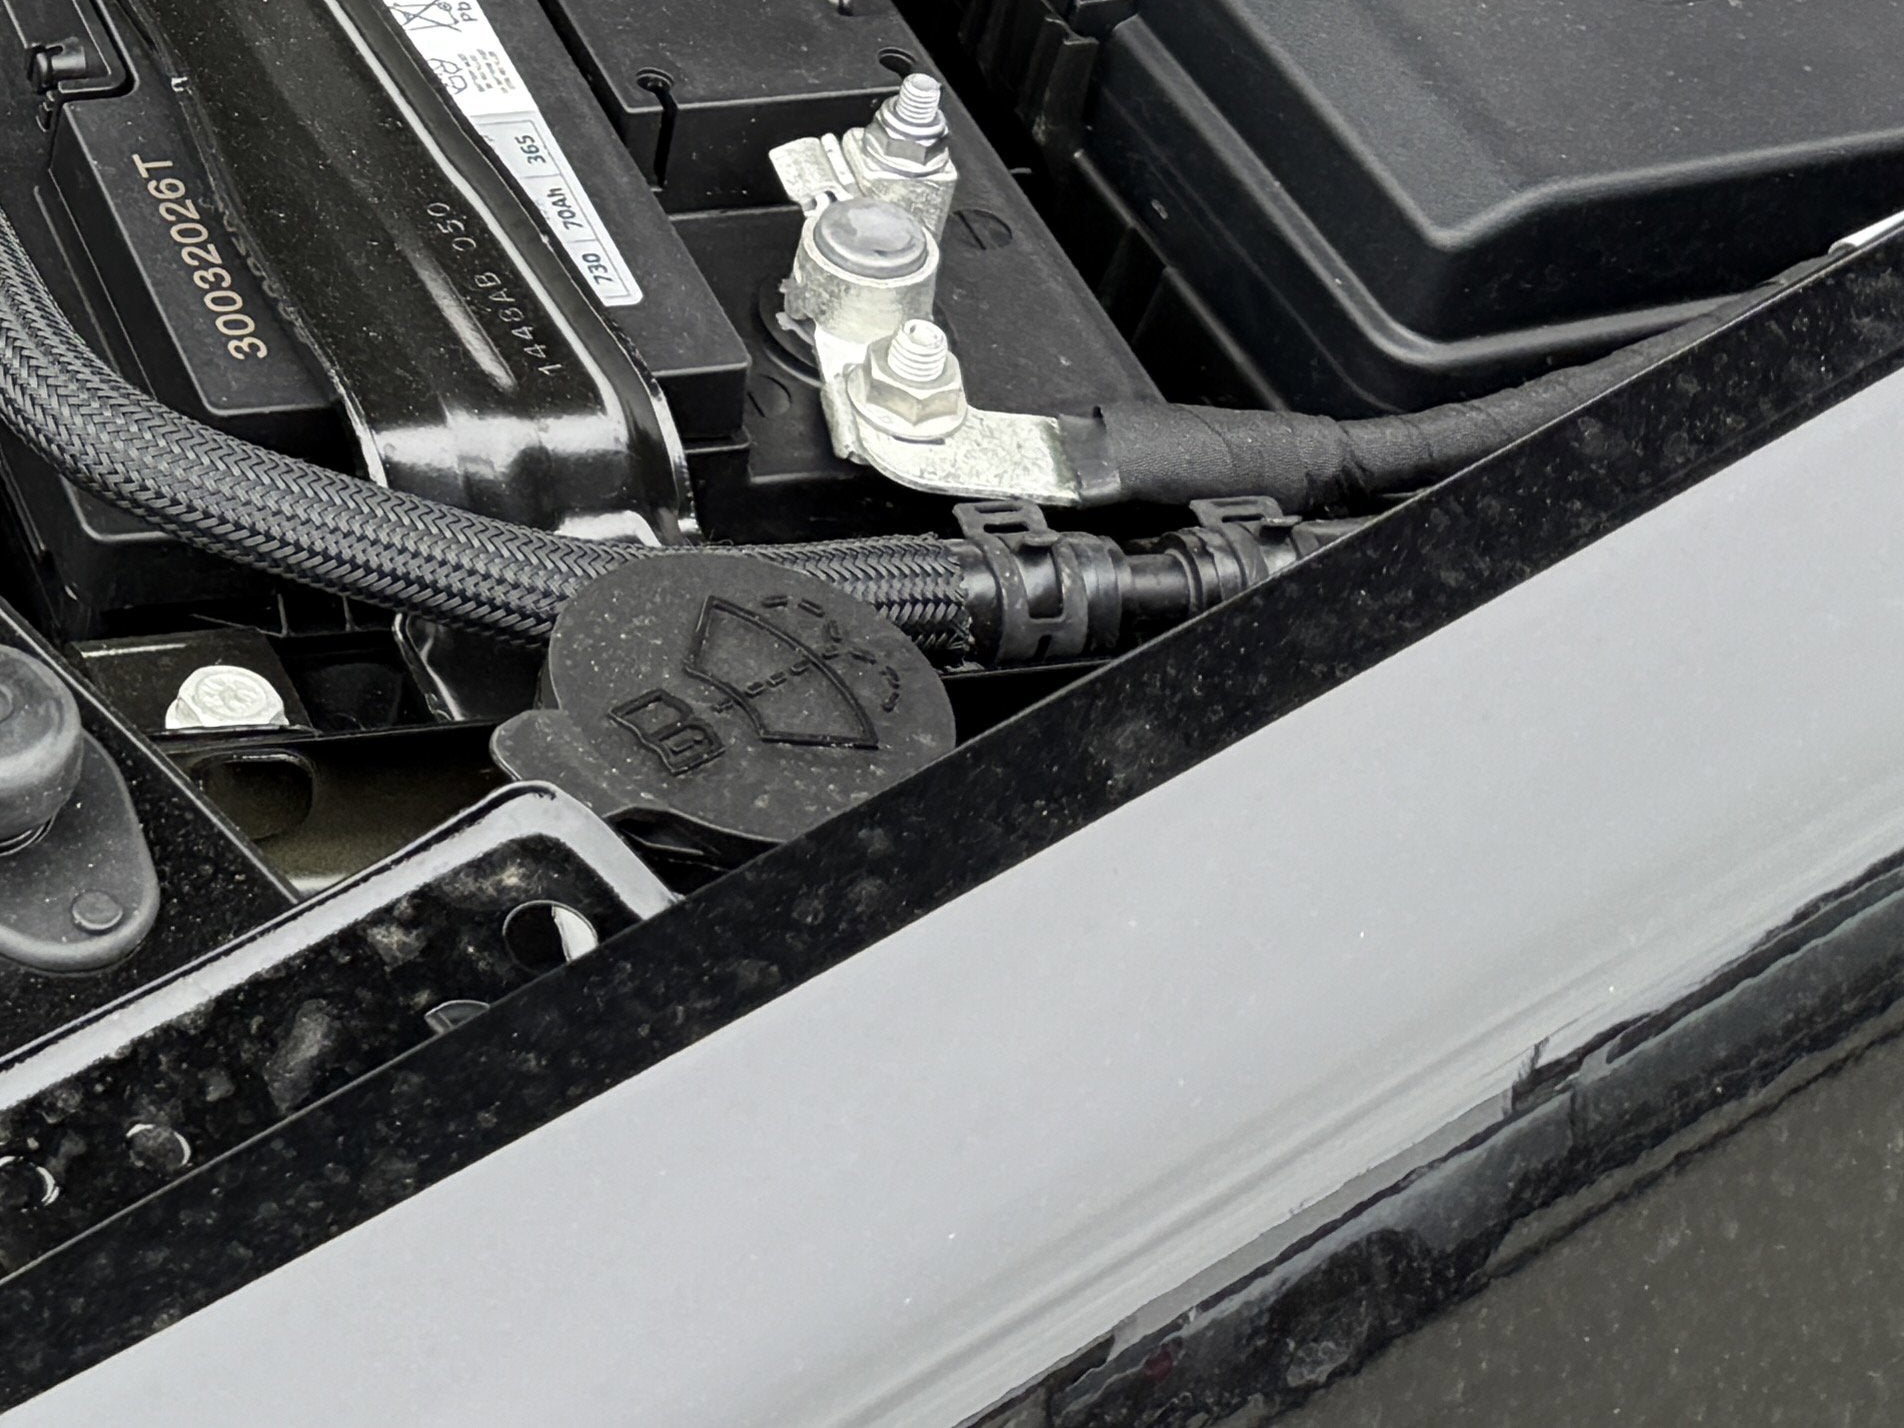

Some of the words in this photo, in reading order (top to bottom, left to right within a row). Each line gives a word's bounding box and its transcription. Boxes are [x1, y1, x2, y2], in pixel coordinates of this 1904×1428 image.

[514, 134, 547, 165] 365
[546, 187, 584, 231] 70Ah
[131, 153, 269, 361] 30032026T
[581, 252, 614, 285] 730
[474, 271, 563, 376] 1448AB
